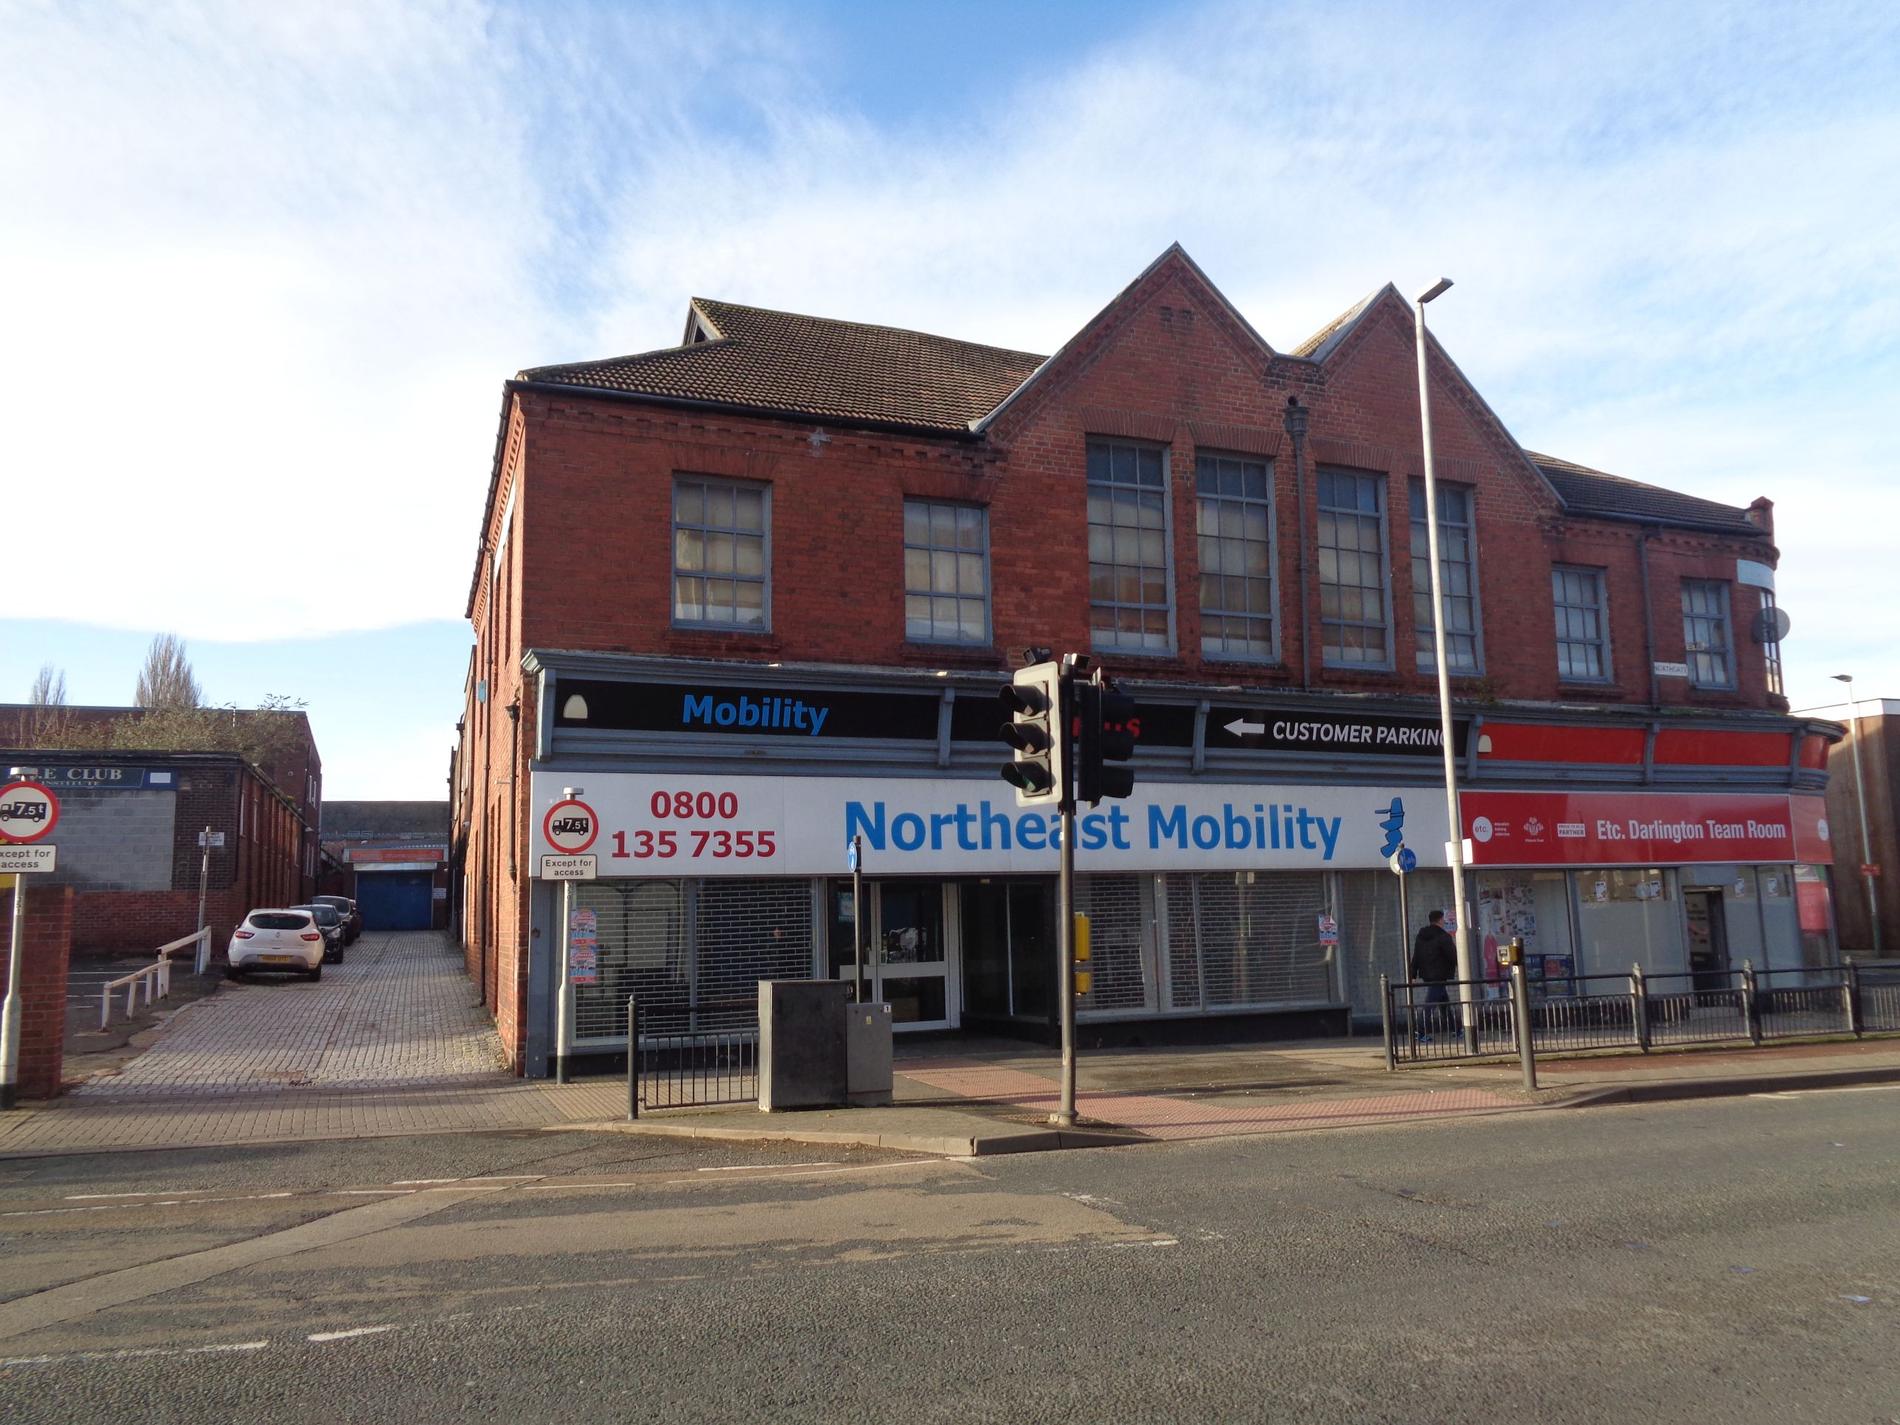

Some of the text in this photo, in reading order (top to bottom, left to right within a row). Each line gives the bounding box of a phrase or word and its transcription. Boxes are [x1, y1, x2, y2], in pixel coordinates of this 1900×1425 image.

[682, 694, 829, 736] Mobility
[1273, 721, 1371, 744] CUSTOMER
[66, 768, 122, 780] CLUB
[650, 791, 738, 819] 0800
[845, 800, 1341, 861] Northeast Mobility
[1597, 819, 1786, 844] Etc. Darlington Team Room
[0, 849, 51, 858] xcept for
[611, 831, 776, 858] 135 7355
[545, 859, 576, 867] Except
